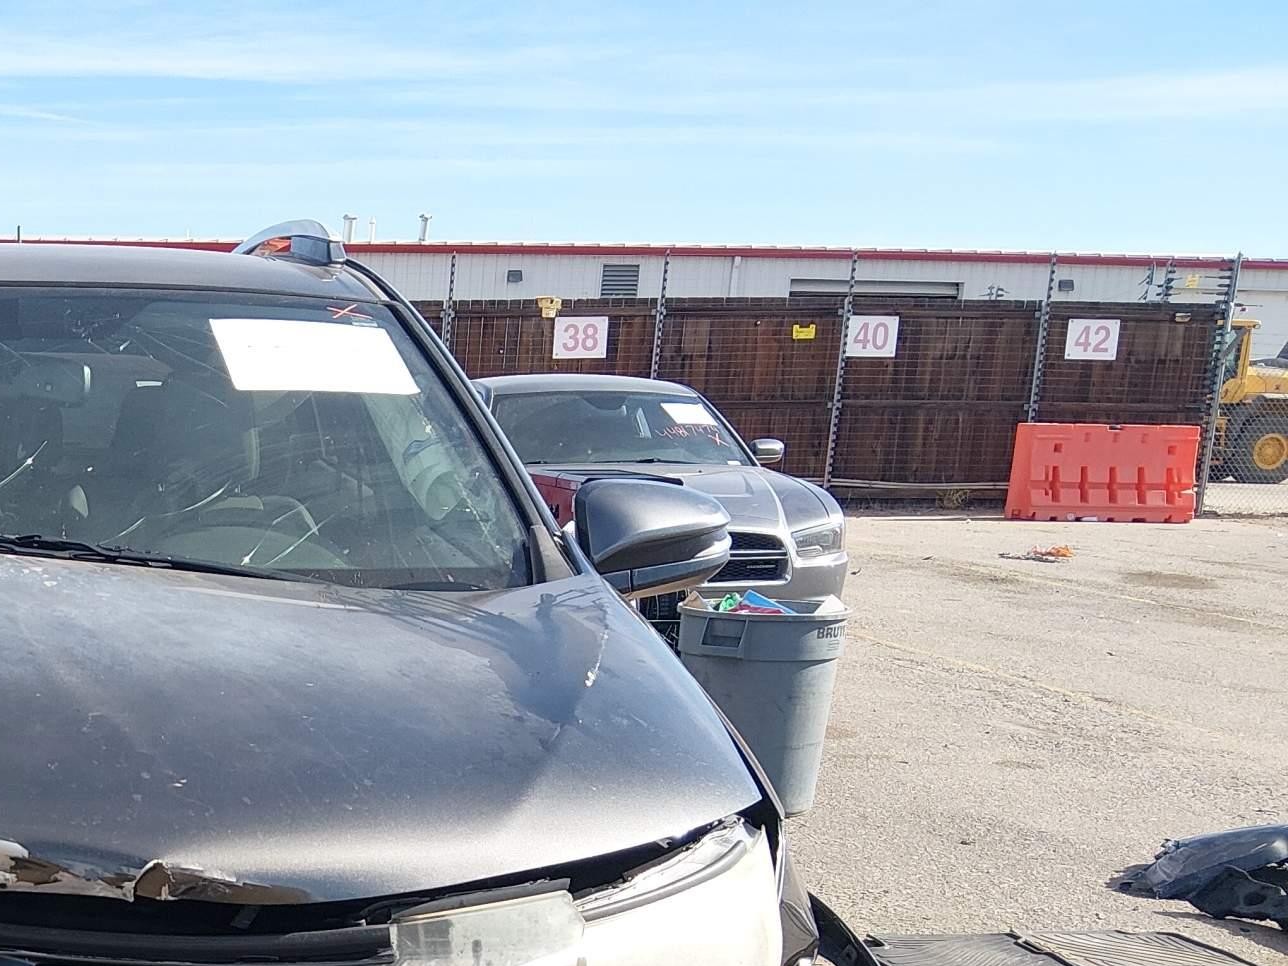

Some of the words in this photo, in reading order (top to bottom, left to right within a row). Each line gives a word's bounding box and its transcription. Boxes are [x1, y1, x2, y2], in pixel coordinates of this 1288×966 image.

[562, 323, 598, 352] 38
[853, 322, 889, 350] 40
[1074, 325, 1111, 353] 42
